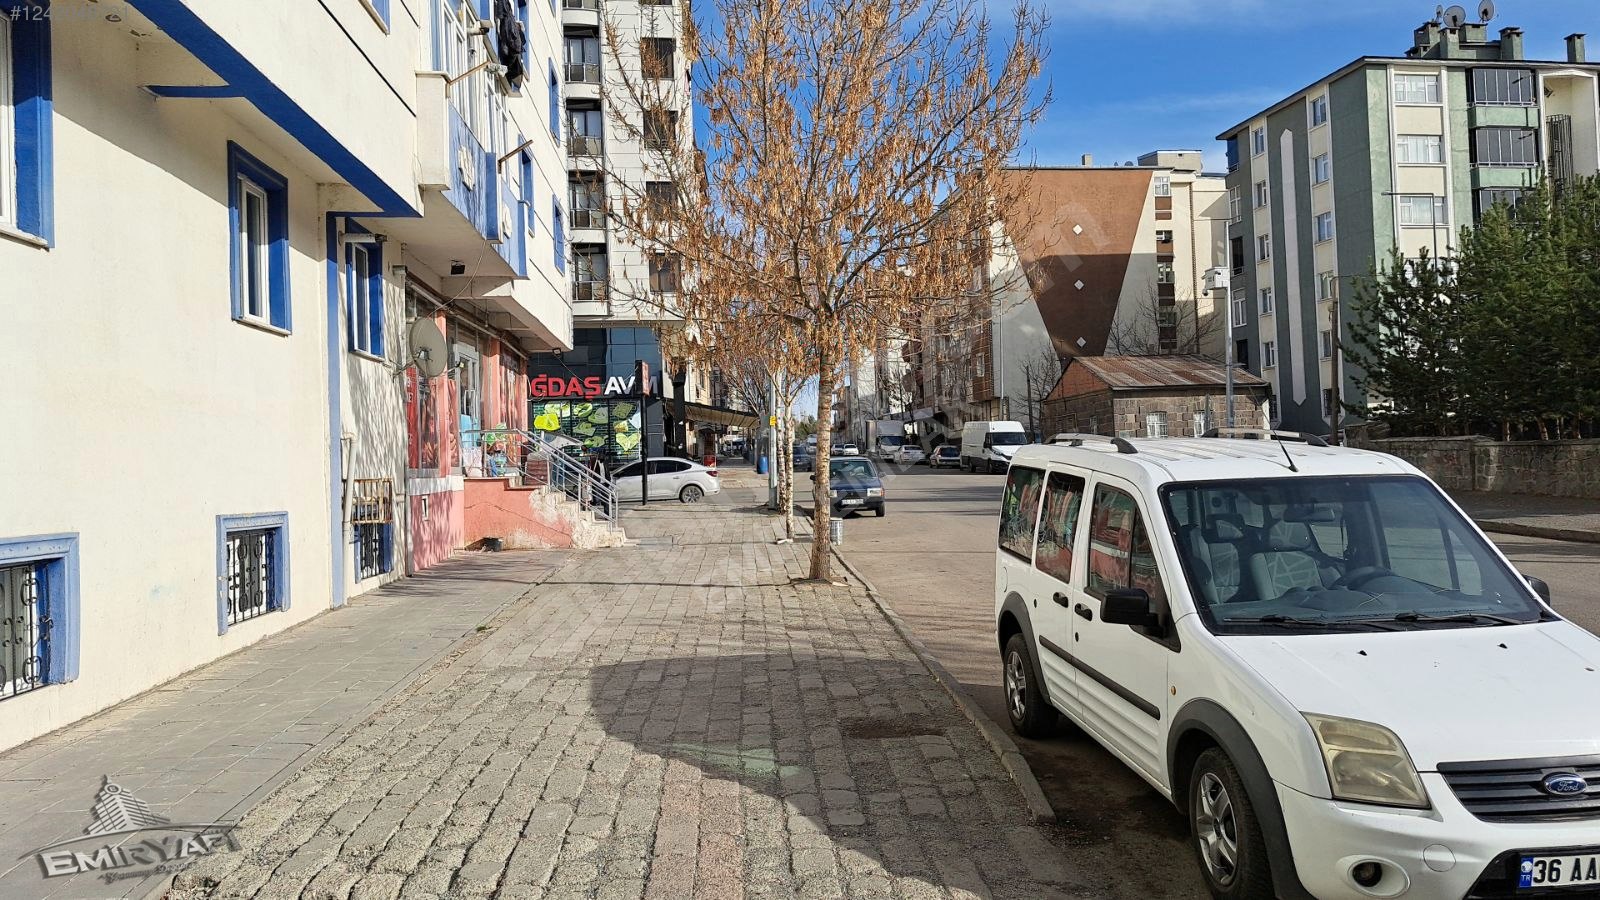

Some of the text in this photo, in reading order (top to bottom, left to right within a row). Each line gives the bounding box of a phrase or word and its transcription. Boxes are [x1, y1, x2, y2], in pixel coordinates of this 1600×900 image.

[1557, 780, 1579, 792] Ford
[1534, 857, 1600, 884] 36 AA
[1521, 874, 1531, 882] TR
